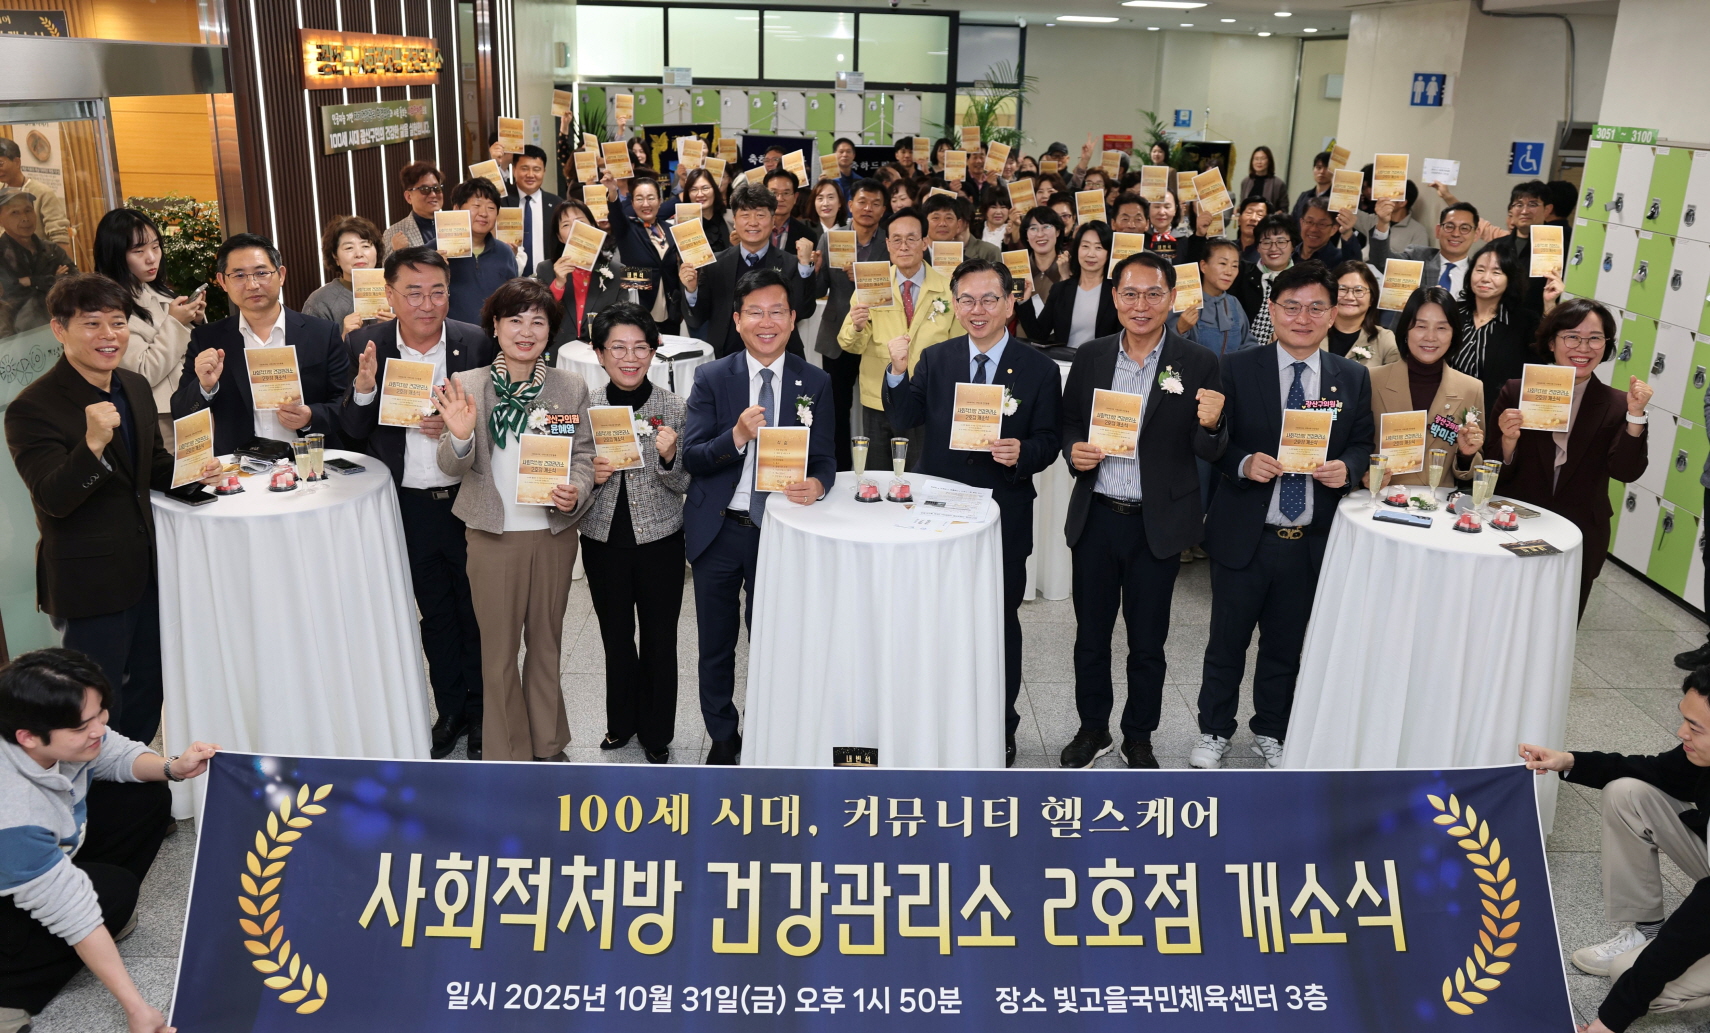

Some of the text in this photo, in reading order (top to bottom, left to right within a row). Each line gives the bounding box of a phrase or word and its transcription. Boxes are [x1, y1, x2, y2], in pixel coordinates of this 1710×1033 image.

[1596, 127, 1616, 140] 3051
[1631, 130, 1653, 143] 3100
[1305, 400, 1336, 408] 광산구의원
[550, 424, 575, 434] 윤혜영
[1430, 422, 1456, 446] 박미옥
[557, 793, 1219, 839] 100세 시대, 커뮤니티 헬스케어
[358, 851, 1407, 956] 사회적처방 건강관리소 2호점 개소식
[445, 981, 1329, 1015] 일시 2025년 10월 31일(금) 오후 1시 50분 장소 빛고을국민체육센터 3층
